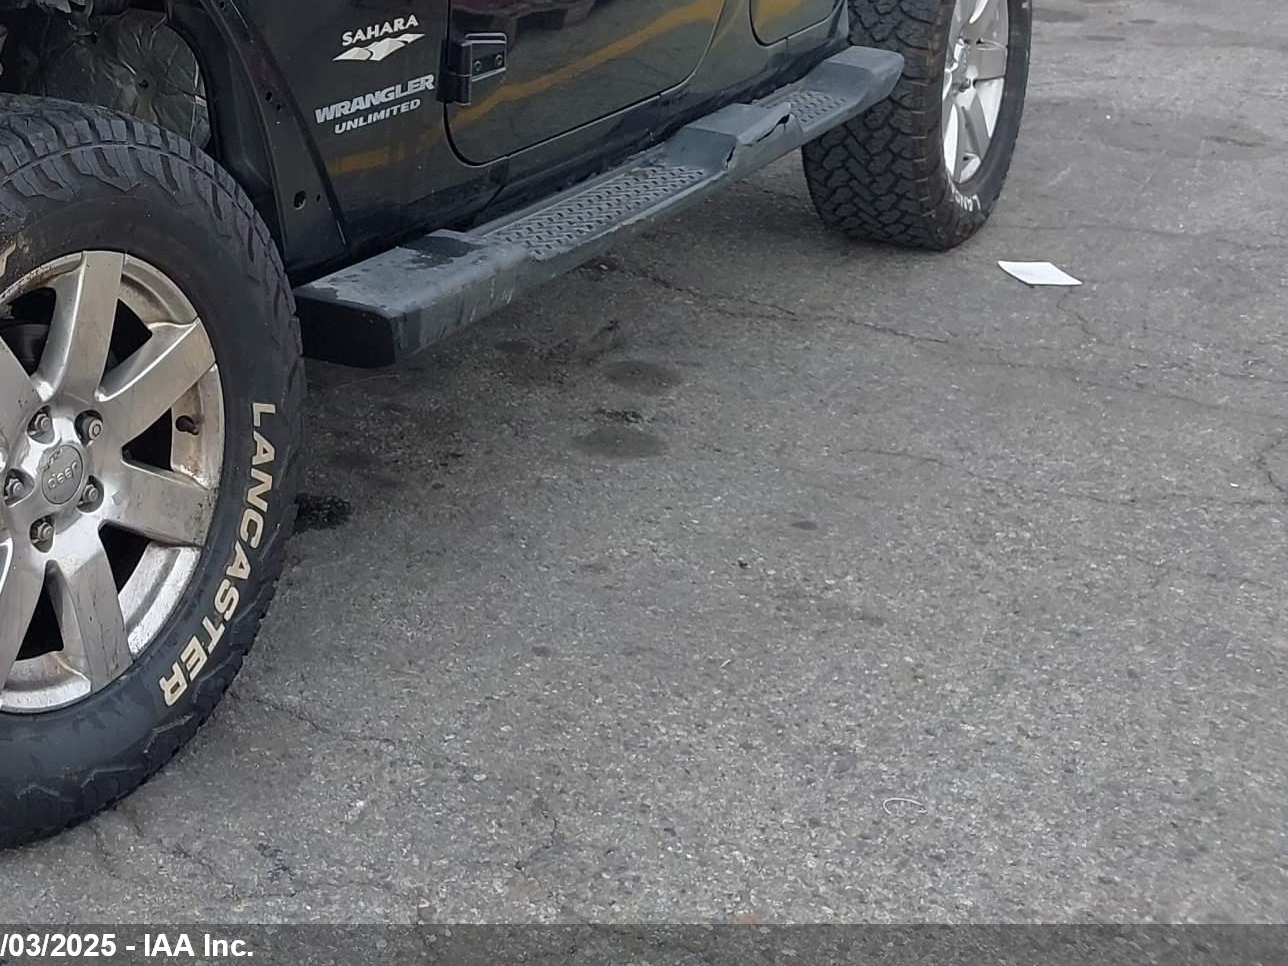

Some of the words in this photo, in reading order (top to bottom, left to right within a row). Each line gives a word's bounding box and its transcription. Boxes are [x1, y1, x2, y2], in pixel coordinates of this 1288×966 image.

[342, 14, 419, 46] SAHARA
[315, 74, 436, 125] WRANGLER
[334, 98, 421, 134] UNLIMITED
[158, 401, 276, 707] LANCASTER
